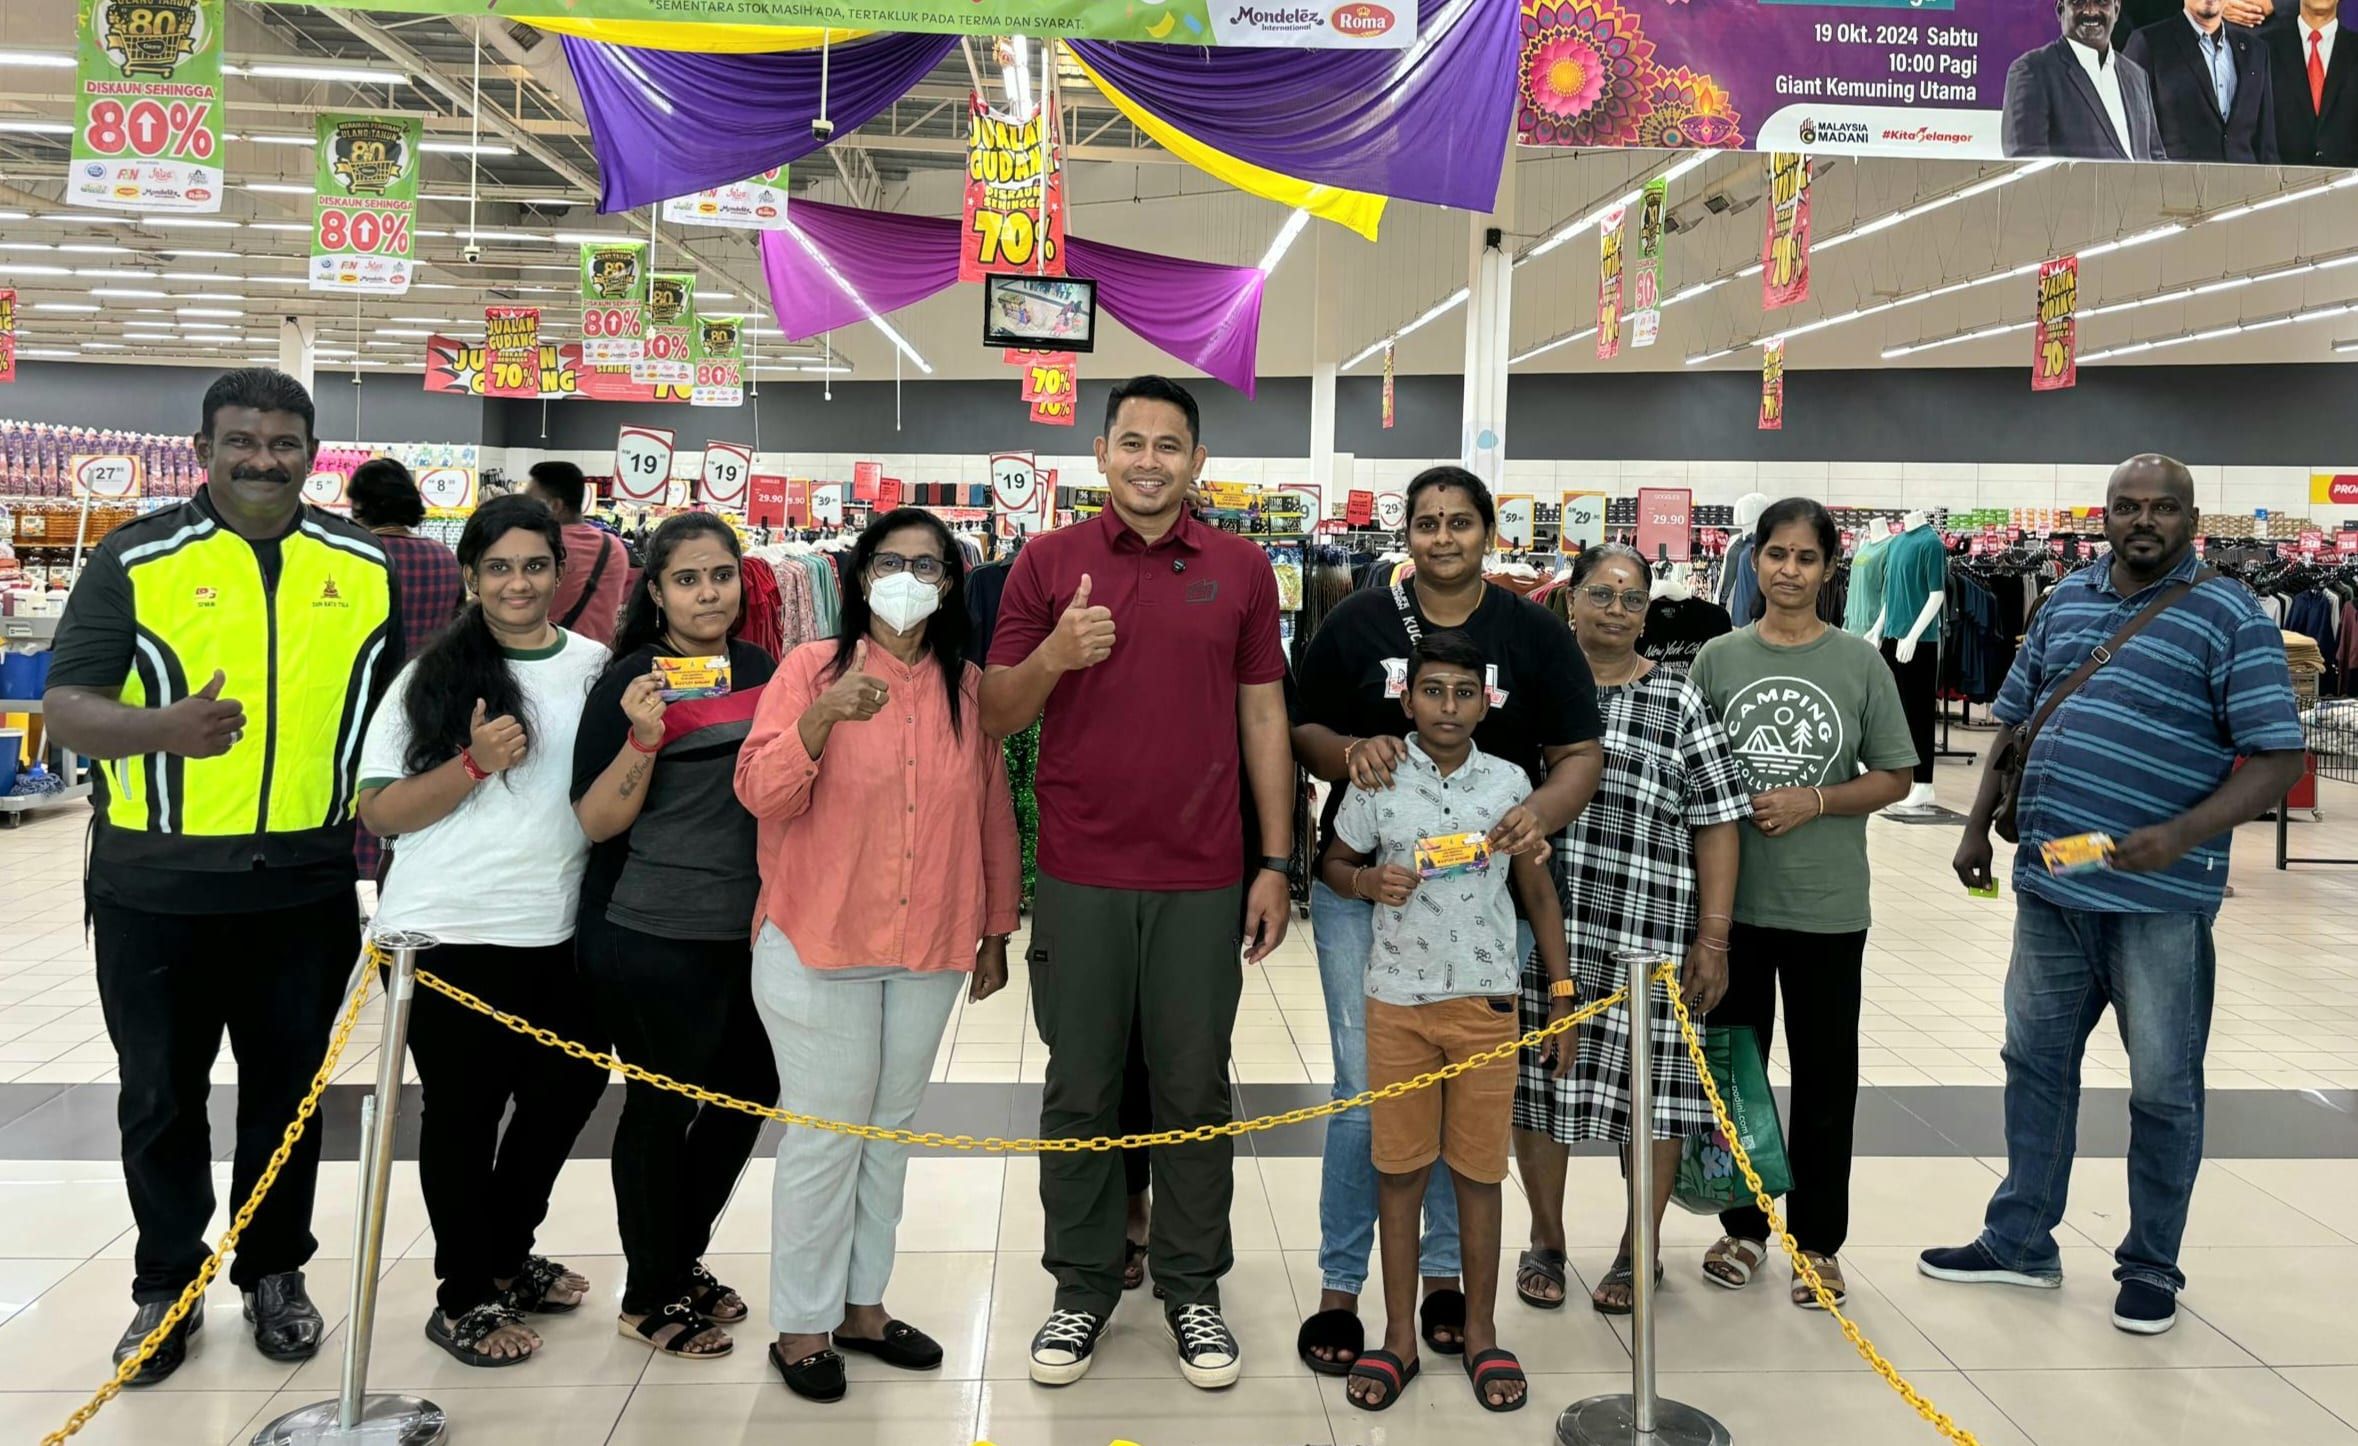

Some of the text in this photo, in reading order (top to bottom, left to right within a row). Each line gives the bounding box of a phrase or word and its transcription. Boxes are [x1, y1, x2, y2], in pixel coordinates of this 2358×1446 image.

[738, 2, 769, 14] STOK
[772, 4, 813, 16] MASIH
[815, 7, 845, 19] ADA,
[848, 8, 918, 22] TERTAKLUK
[921, 13, 954, 25] PADA
[959, 14, 1000, 26] TERMA
[1005, 16, 1031, 27] DAN
[1034, 17, 1085, 30] SYARAT.
[1340, 13, 1387, 29] Roma
[1262, 23, 1311, 32] International
[1814, 24, 1978, 47] 19 Okt. 2024 Sabtu
[1889, 53, 1978, 79] 10:00 Pagi
[86, 81, 214, 98] DISKAUN SEHINGGA
[1776, 75, 1977, 103] Giant Kemuning Utama
[87, 100, 213, 158] 80%
[1818, 122, 1868, 132] MALAYSIA
[1818, 131, 1869, 143] MADANI
[319, 196, 414, 210] DISKAUN SEHINGGA
[320, 210, 409, 253] 80%
[487, 317, 537, 336] JUALAN
[584, 309, 641, 337] 80%
[488, 333, 537, 350] GUDANG
[492, 363, 534, 388] 70%
[697, 365, 740, 385] 80%
[1031, 367, 1072, 395] 70%
[631, 453, 657, 474] 19
[95, 467, 116, 480] 27
[715, 464, 737, 482] 19
[1003, 472, 1025, 490] 19
[316, 480, 323, 490] 5
[437, 479, 446, 492] 8
[758, 493, 783, 503] 29.90
[818, 496, 831, 506] 39
[1385, 503, 1398, 515] 29
[1505, 513, 1517, 523] 59
[1574, 511, 1590, 525] 29
[1653, 514, 1685, 525] 29.90
[1402, 615, 1424, 646] KUC
[1644, 644, 1665, 658] New
[1661, 640, 1684, 661] York
[1728, 688, 1832, 743] CAMPING
[1731, 1085, 1749, 1135] padini.com
